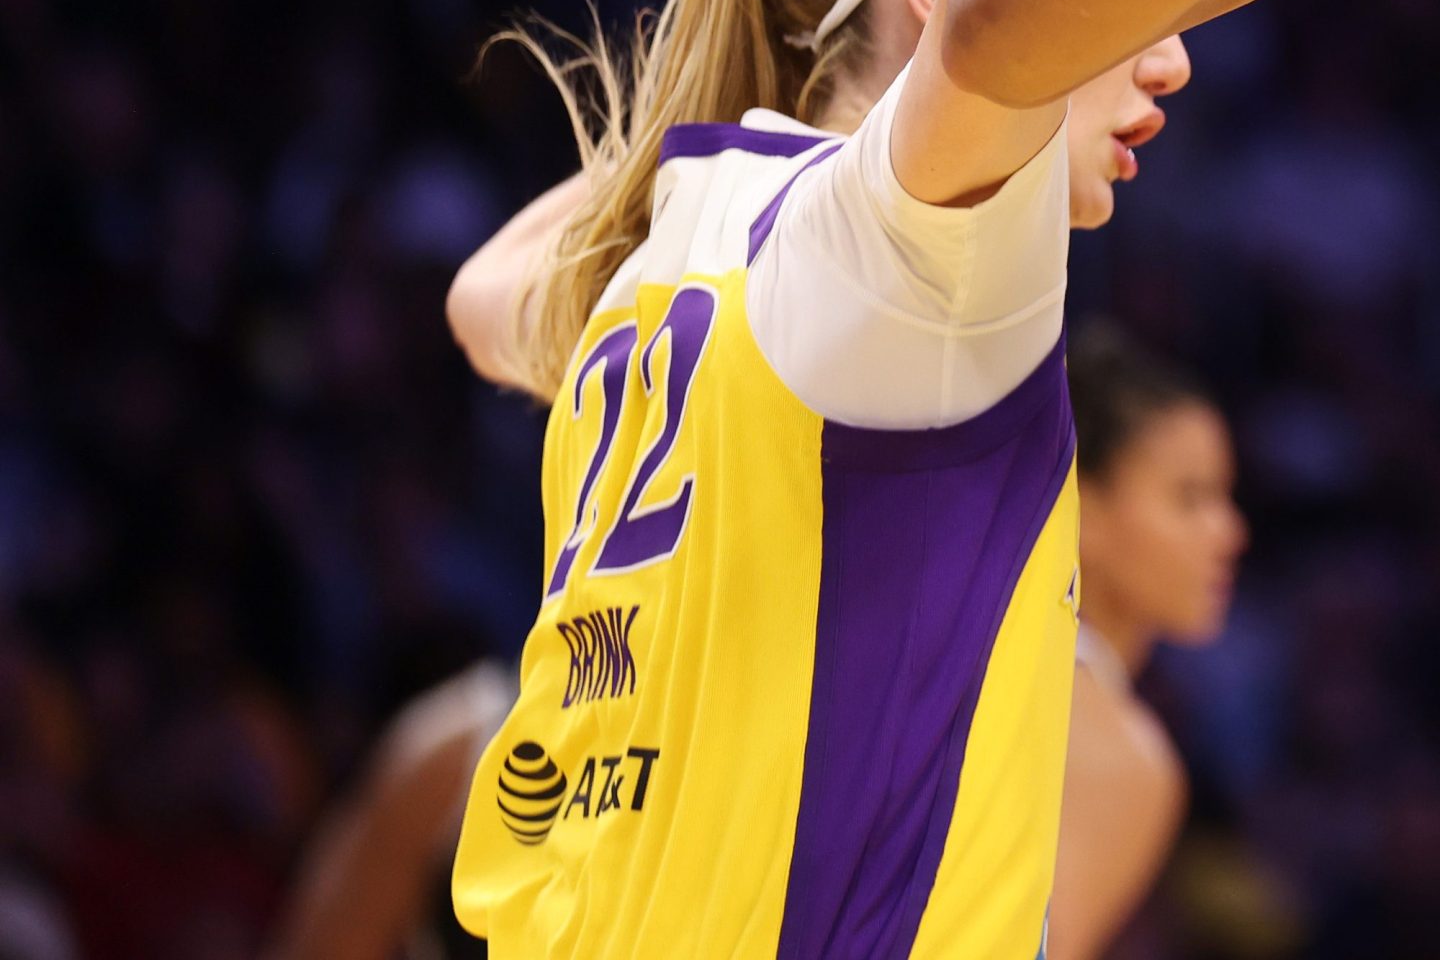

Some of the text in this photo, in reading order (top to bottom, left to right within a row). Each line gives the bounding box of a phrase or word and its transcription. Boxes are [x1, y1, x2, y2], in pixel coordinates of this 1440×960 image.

[541, 283, 719, 604] 22
[556, 604, 640, 709] BRINK
[563, 746, 660, 820] AT&T
